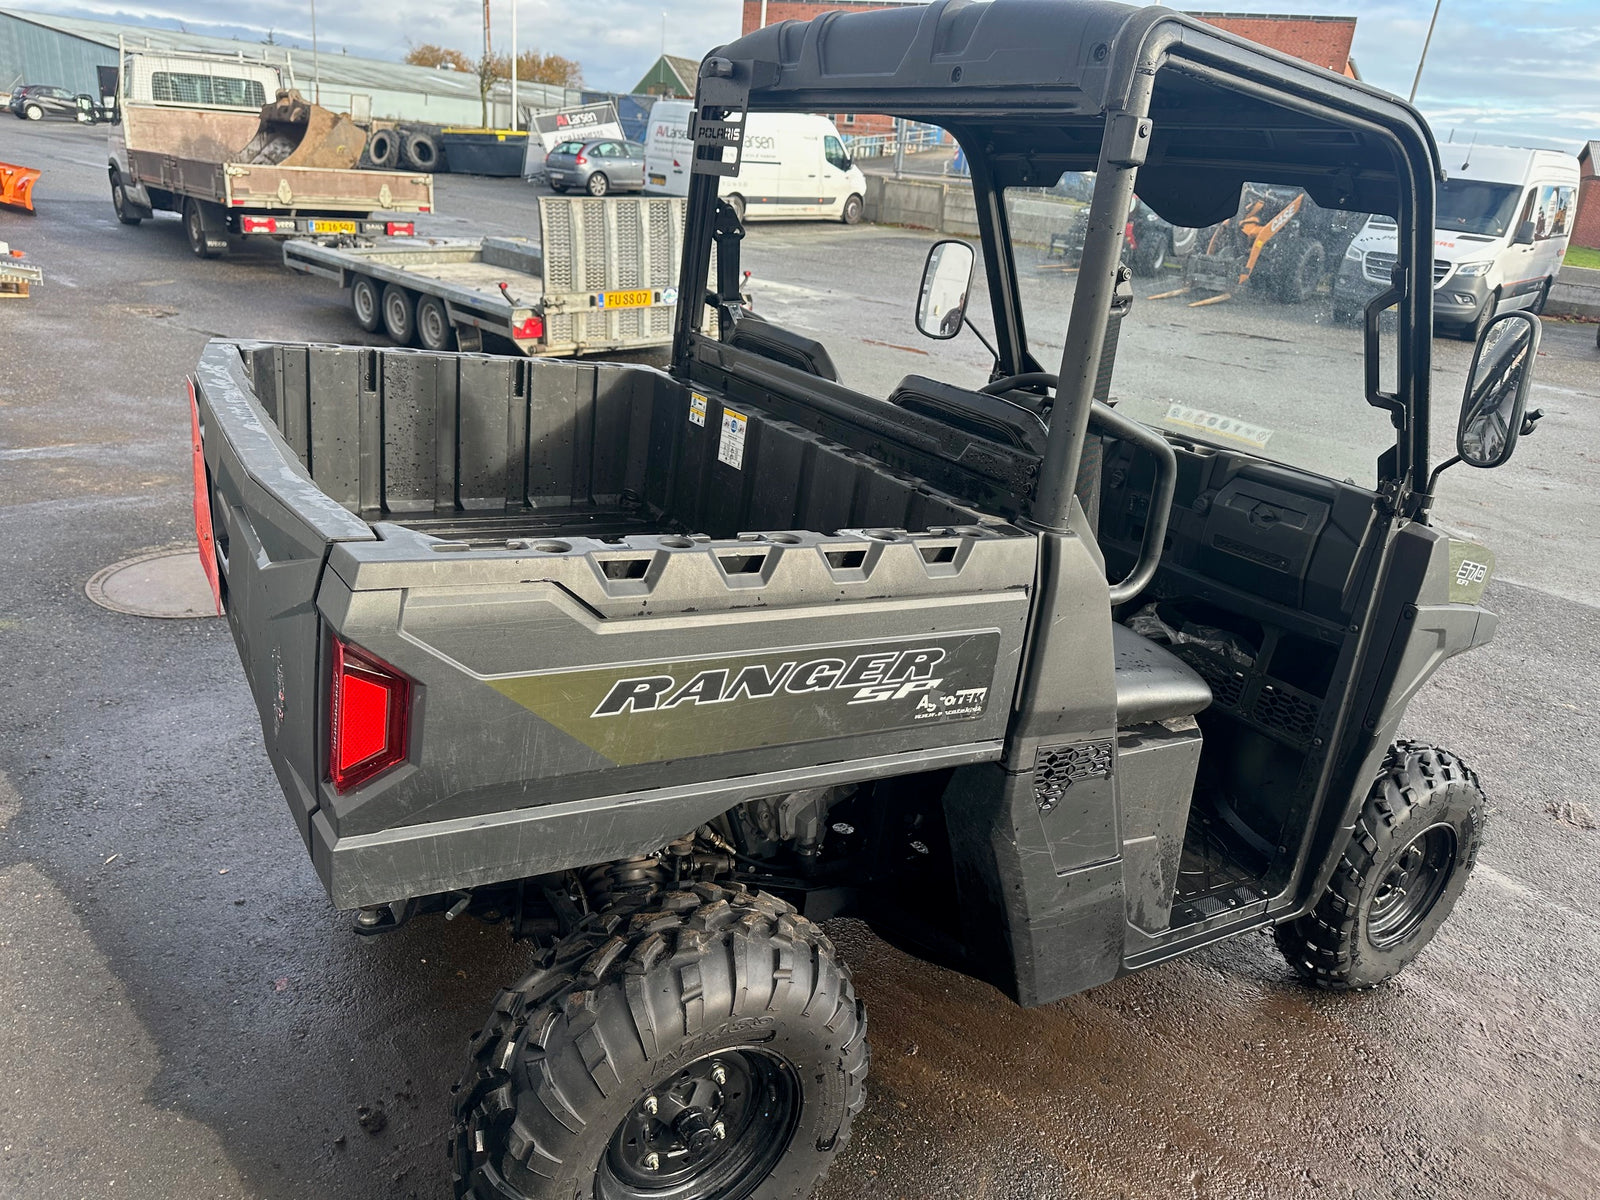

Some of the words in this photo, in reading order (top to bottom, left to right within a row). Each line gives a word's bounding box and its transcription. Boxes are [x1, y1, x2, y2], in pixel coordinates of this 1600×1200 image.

[698, 126, 741, 141] POLARIS
[743, 135, 775, 149] arsen
[1271, 204, 1296, 233] CASE
[608, 294, 621, 306] FU
[623, 293, 635, 305] SS
[636, 292, 648, 304] 07
[1456, 559, 1488, 583] 570
[590, 647, 946, 718] RANGER
[846, 678, 944, 705] SP
